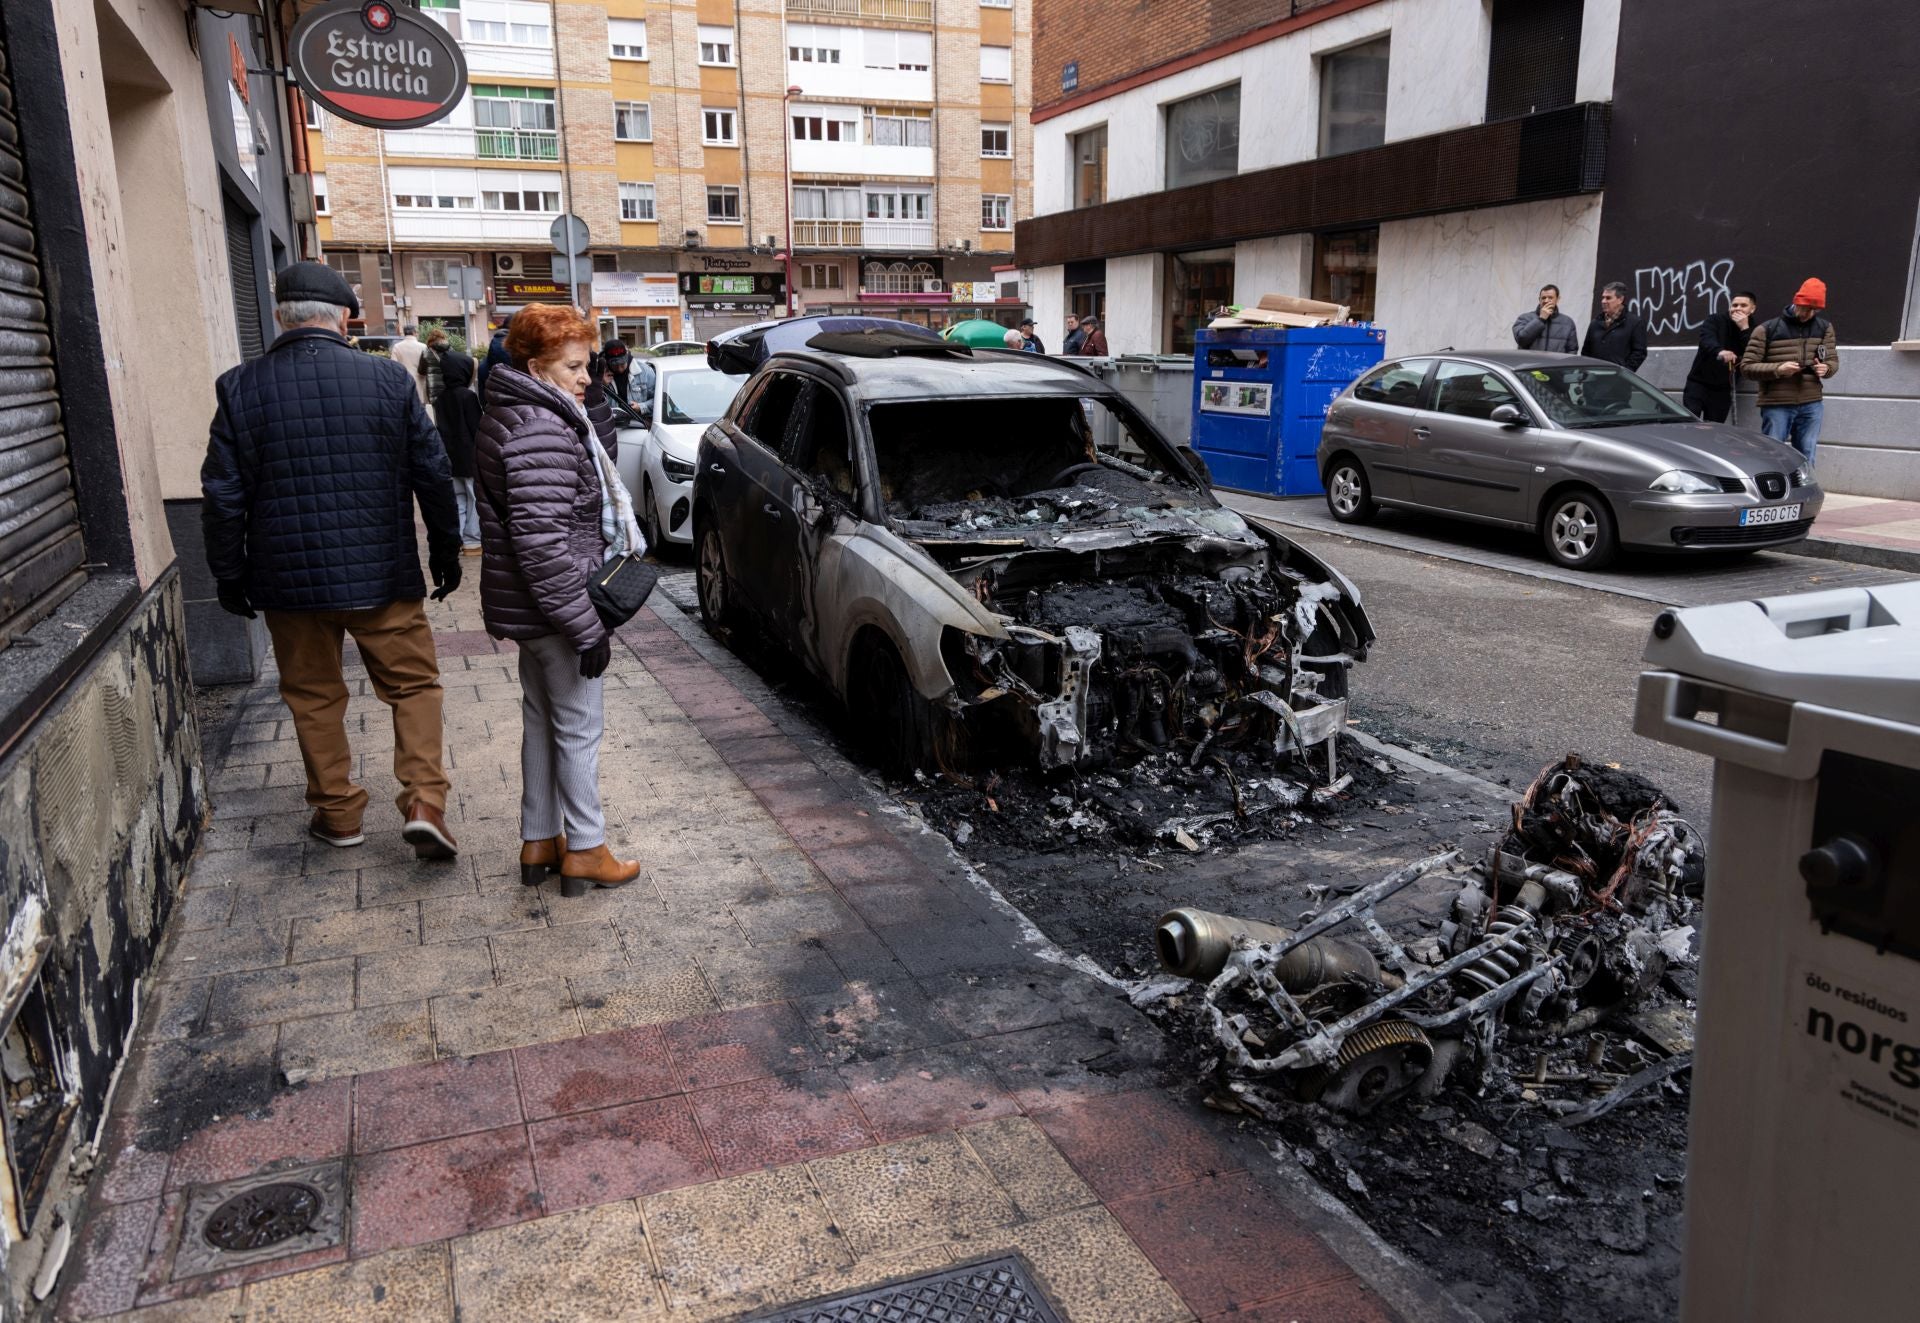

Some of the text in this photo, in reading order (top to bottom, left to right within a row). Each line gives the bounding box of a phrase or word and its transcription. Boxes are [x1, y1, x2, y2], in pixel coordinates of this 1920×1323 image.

[326, 29, 433, 68] Estrella
[332, 58, 429, 96] Galicia
[523, 285, 556, 293] TABACOS
[1748, 505, 1798, 523] 5560 CTS
[1835, 985, 1908, 1023] residuos
[1806, 1006, 1920, 1089] norg
